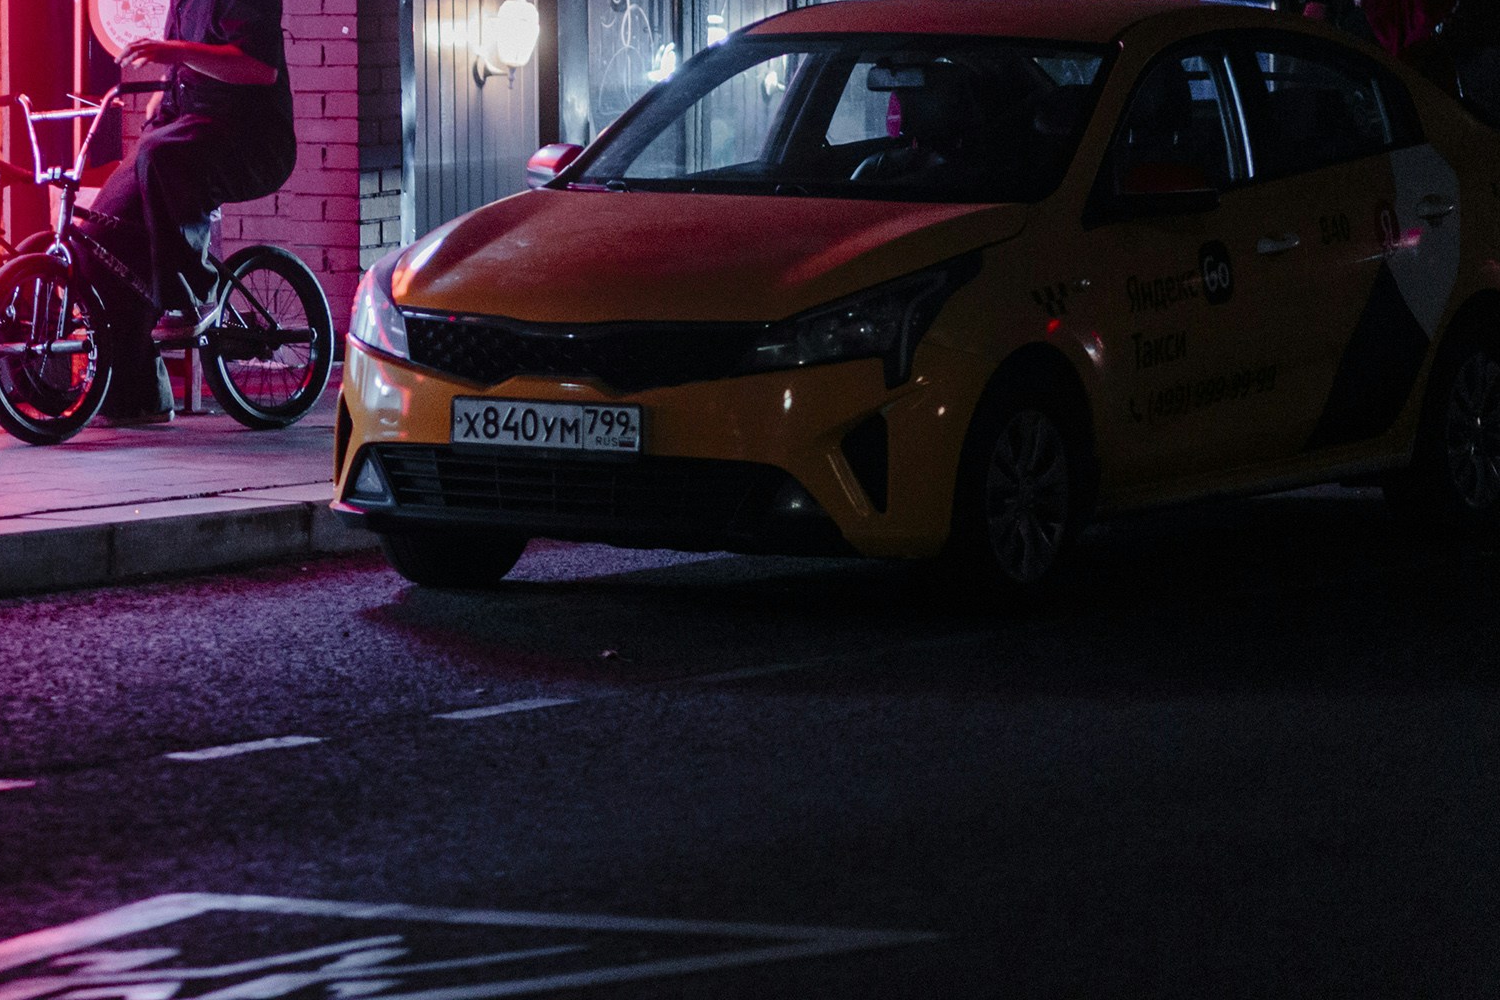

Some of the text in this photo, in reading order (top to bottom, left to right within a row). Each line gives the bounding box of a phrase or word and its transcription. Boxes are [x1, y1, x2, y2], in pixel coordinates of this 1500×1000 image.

[1126, 270, 1199, 313] Яндекс
[1132, 331, 1187, 370] Такси
[585, 408, 631, 436] 799
[595, 437, 618, 447] RUS
